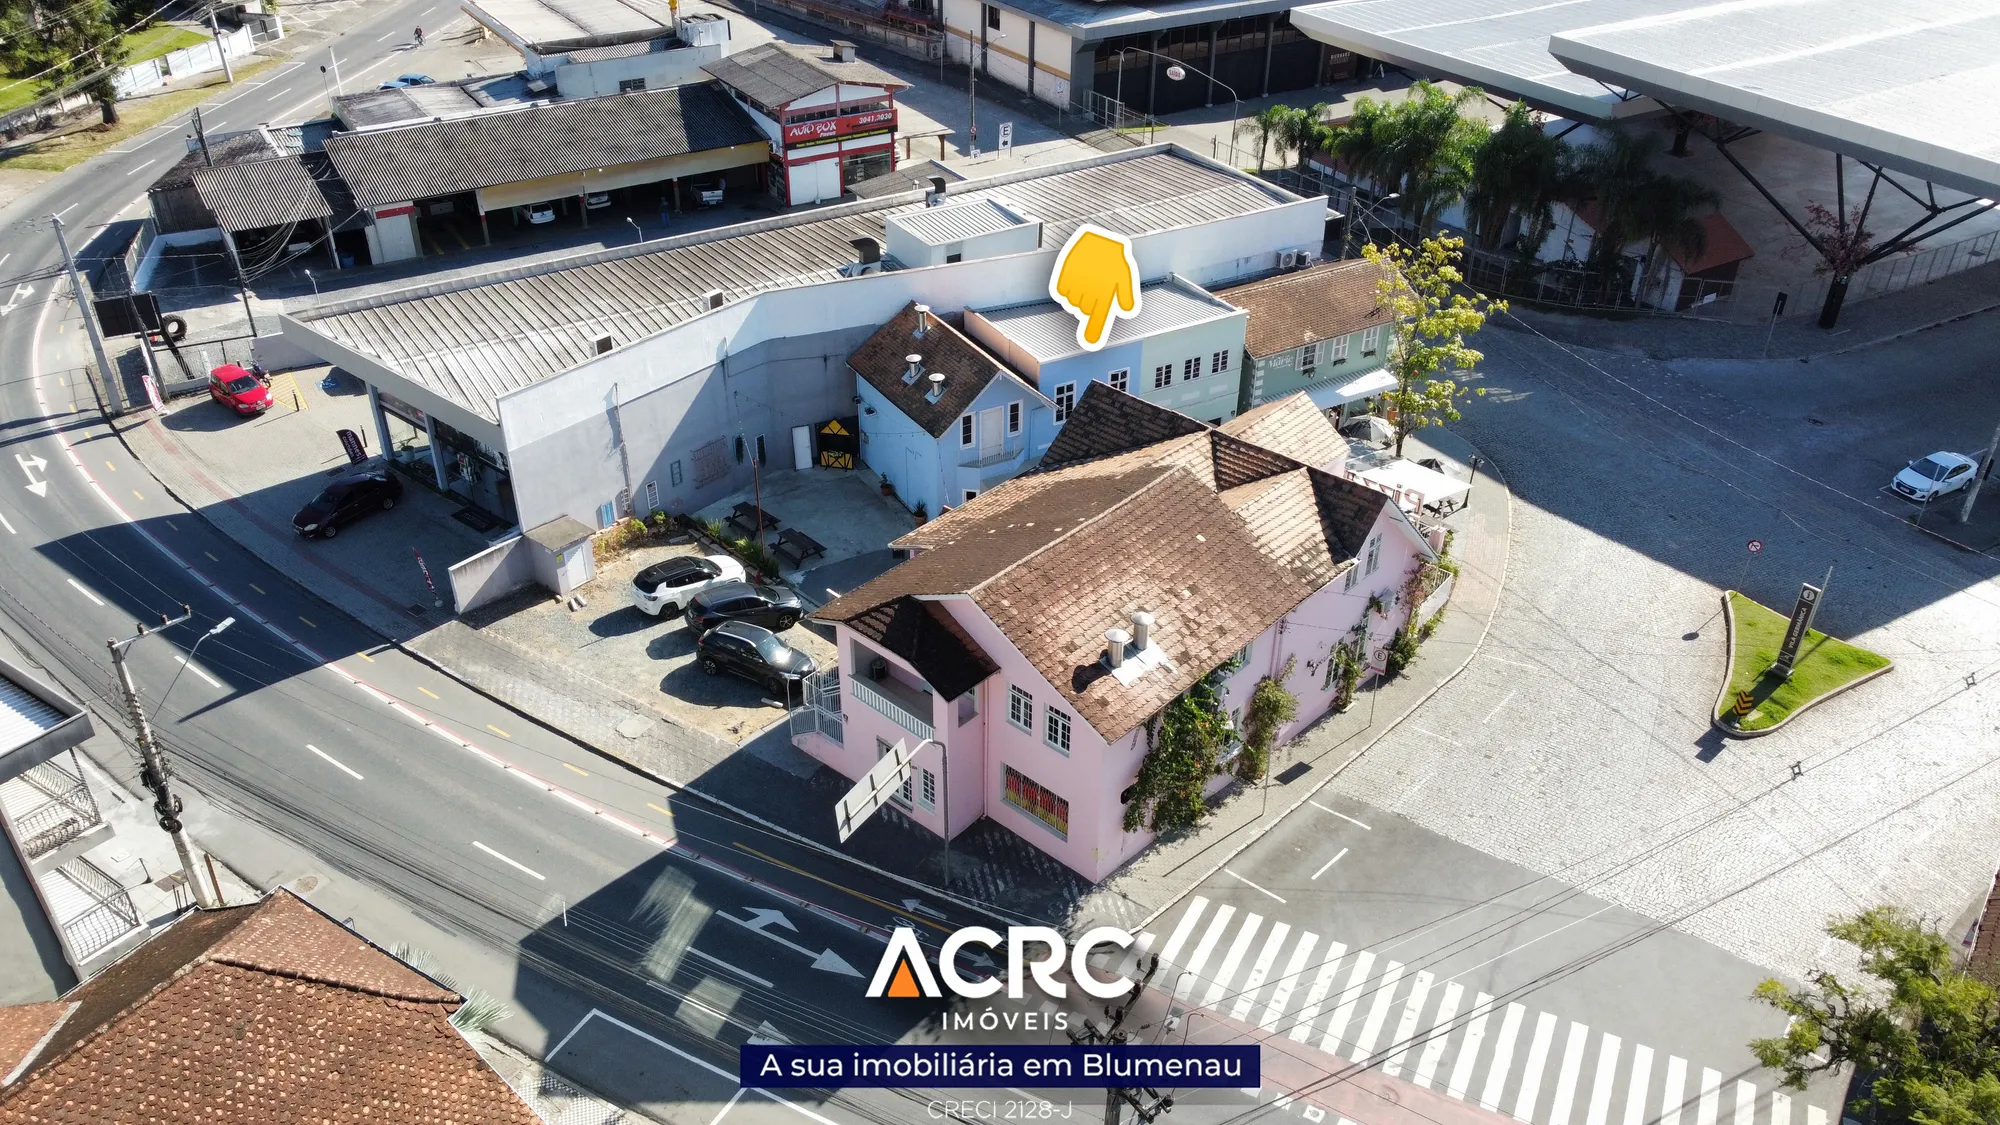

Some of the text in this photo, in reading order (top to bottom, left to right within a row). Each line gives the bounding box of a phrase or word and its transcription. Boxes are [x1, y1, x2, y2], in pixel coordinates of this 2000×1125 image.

[790, 120, 836, 137] AUTO BOX
[1003, 126, 1009, 136] E
[346, 431, 362, 457] mannes
